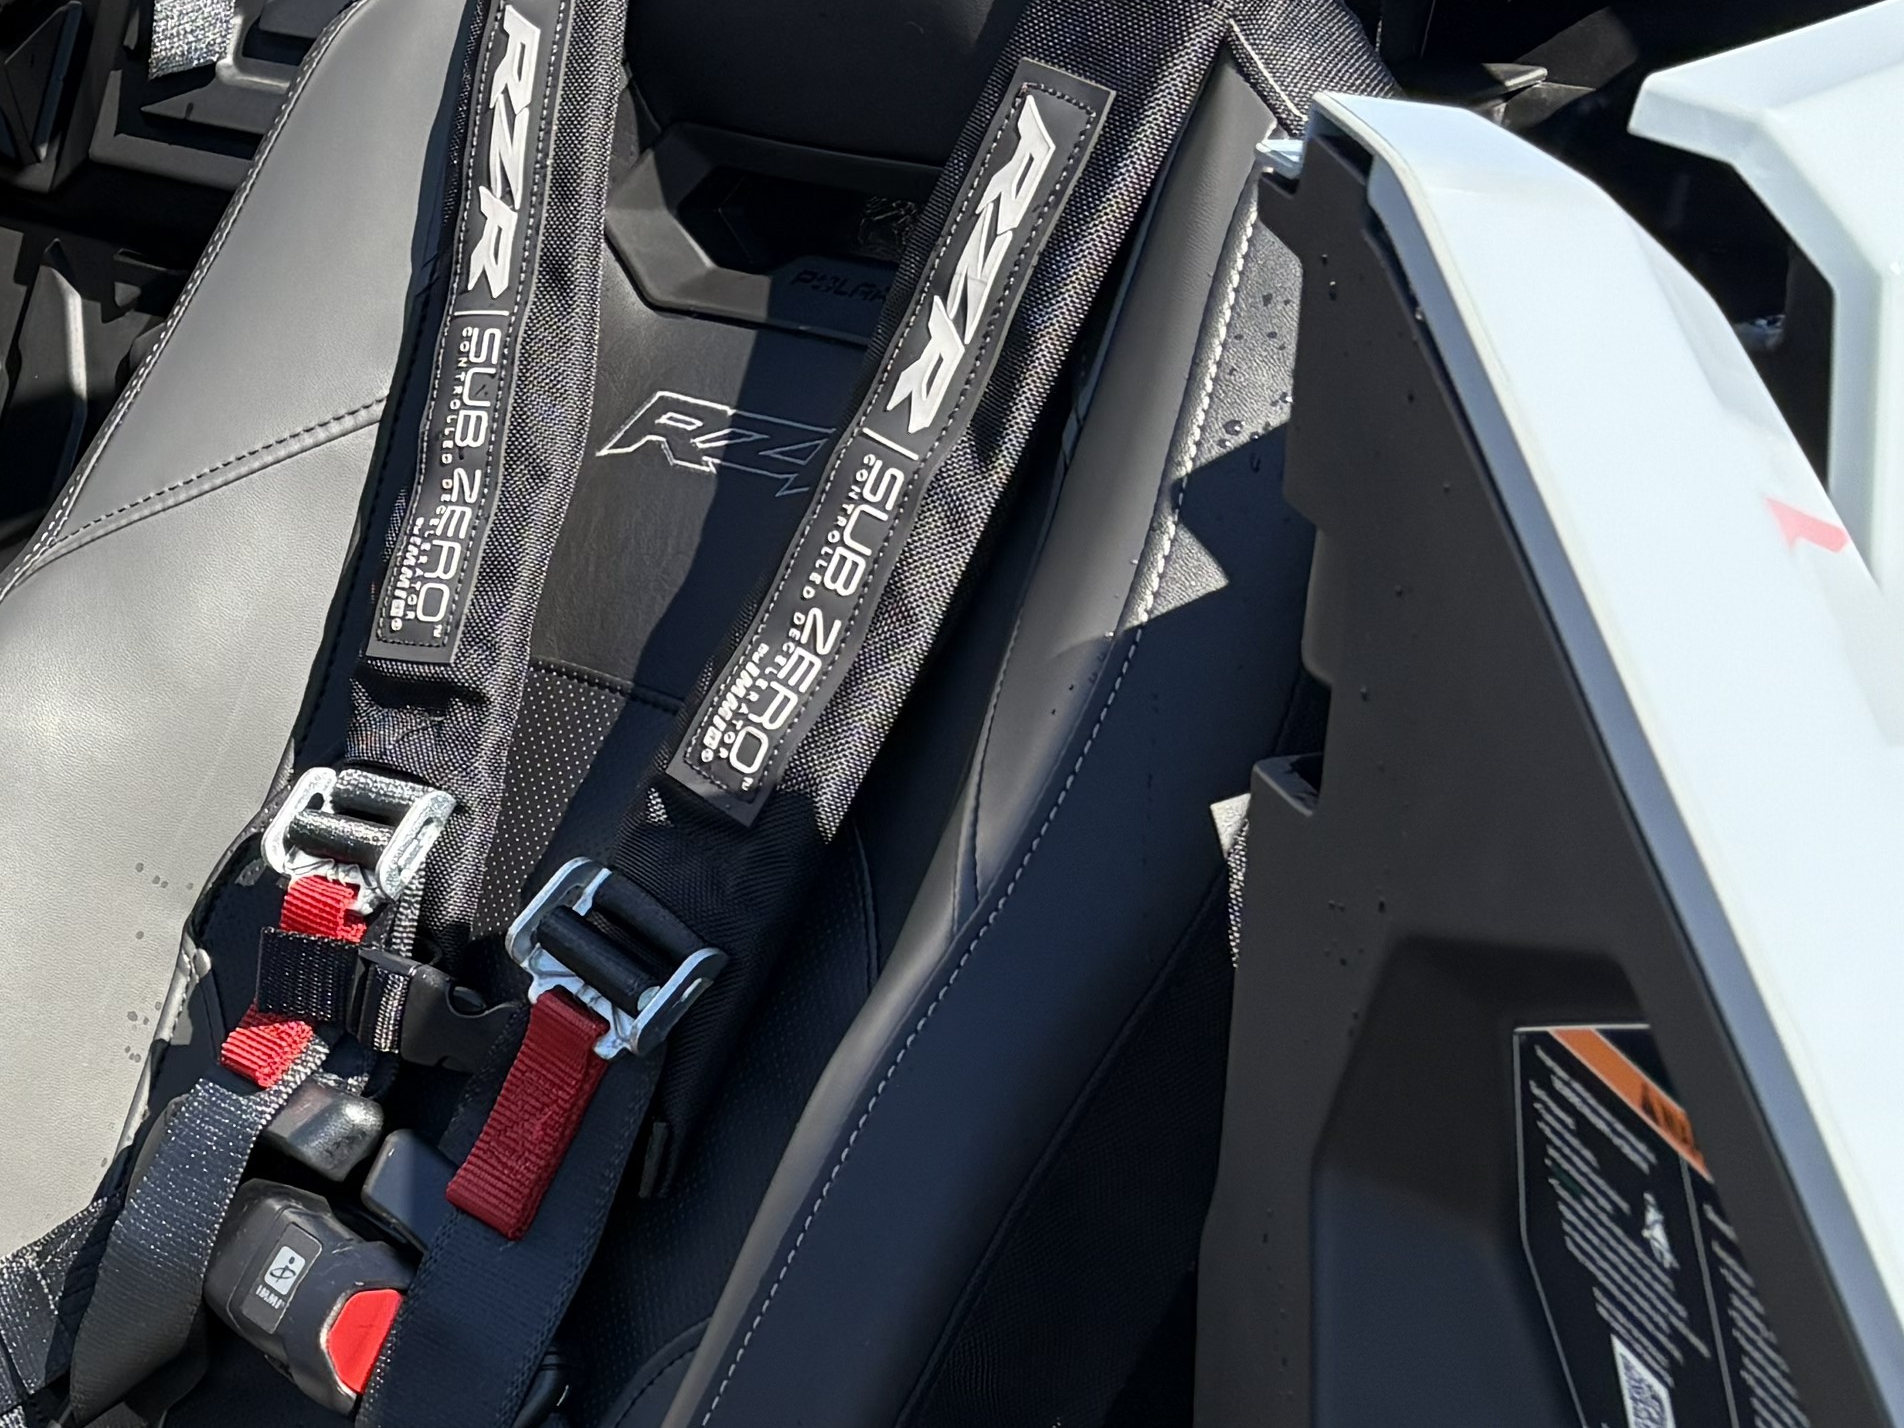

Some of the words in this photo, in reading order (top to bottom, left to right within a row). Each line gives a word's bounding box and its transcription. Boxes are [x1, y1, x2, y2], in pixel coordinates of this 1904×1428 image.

[468, 4, 542, 300] RZR
[886, 94, 1056, 436] RZR
[441, 326, 473, 466] CONTROLLED
[454, 327, 502, 448] SUB
[393, 534, 422, 600] IMMI
[405, 478, 453, 621] DECELERATOR
[415, 468, 482, 623] ZERO
[801, 453, 877, 600] CONTROLLED
[822, 458, 905, 597] SUB
[712, 660, 761, 732] IMMI
[717, 610, 807, 760] DECELERATOR
[728, 607, 842, 774] ZERO
